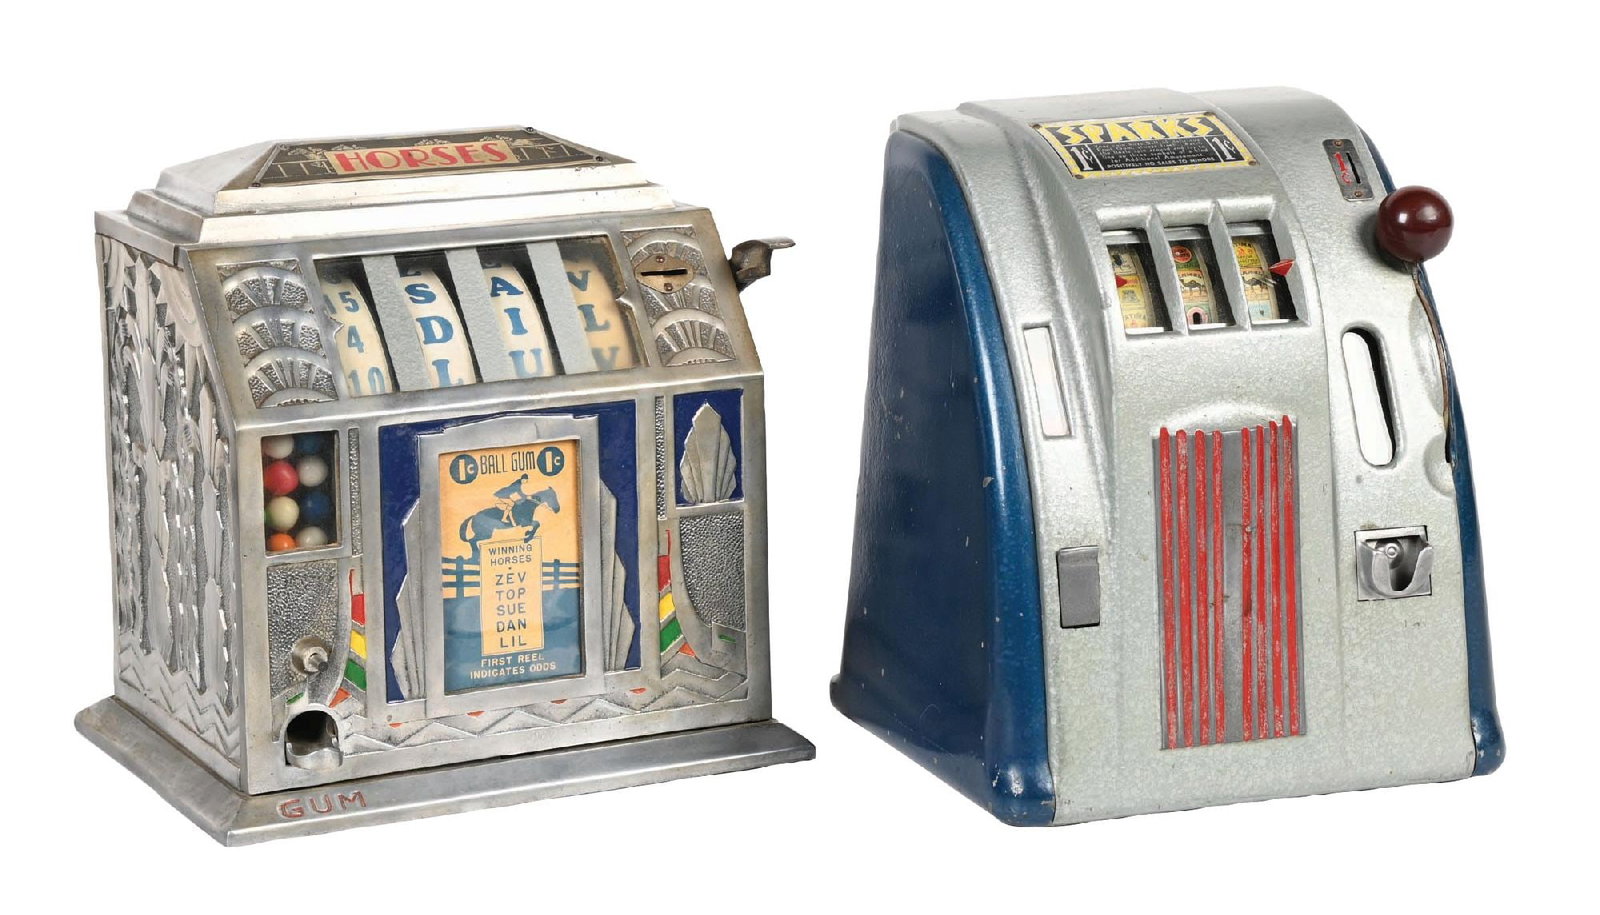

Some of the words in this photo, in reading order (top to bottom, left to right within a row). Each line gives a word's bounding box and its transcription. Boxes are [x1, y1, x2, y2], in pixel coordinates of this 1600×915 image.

[1057, 117, 1213, 144] SPARKS
[334, 142, 508, 173] HORSES
[480, 453, 508, 475] BALL
[511, 451, 536, 471] GUM
[488, 543, 533, 556] WINNING
[490, 554, 532, 567] HORSES
[495, 572, 527, 586] ZEV
[495, 587, 527, 601] TOP
[496, 603, 526, 616] SUE
[496, 618, 527, 633] DAN
[499, 635, 528, 649] LIL
[481, 655, 513, 668] FIRST
[517, 653, 545, 664] REEL
[470, 666, 526, 680] INDICATES
[529, 662, 557, 673] ODDS
[277, 790, 367, 819] GUM
